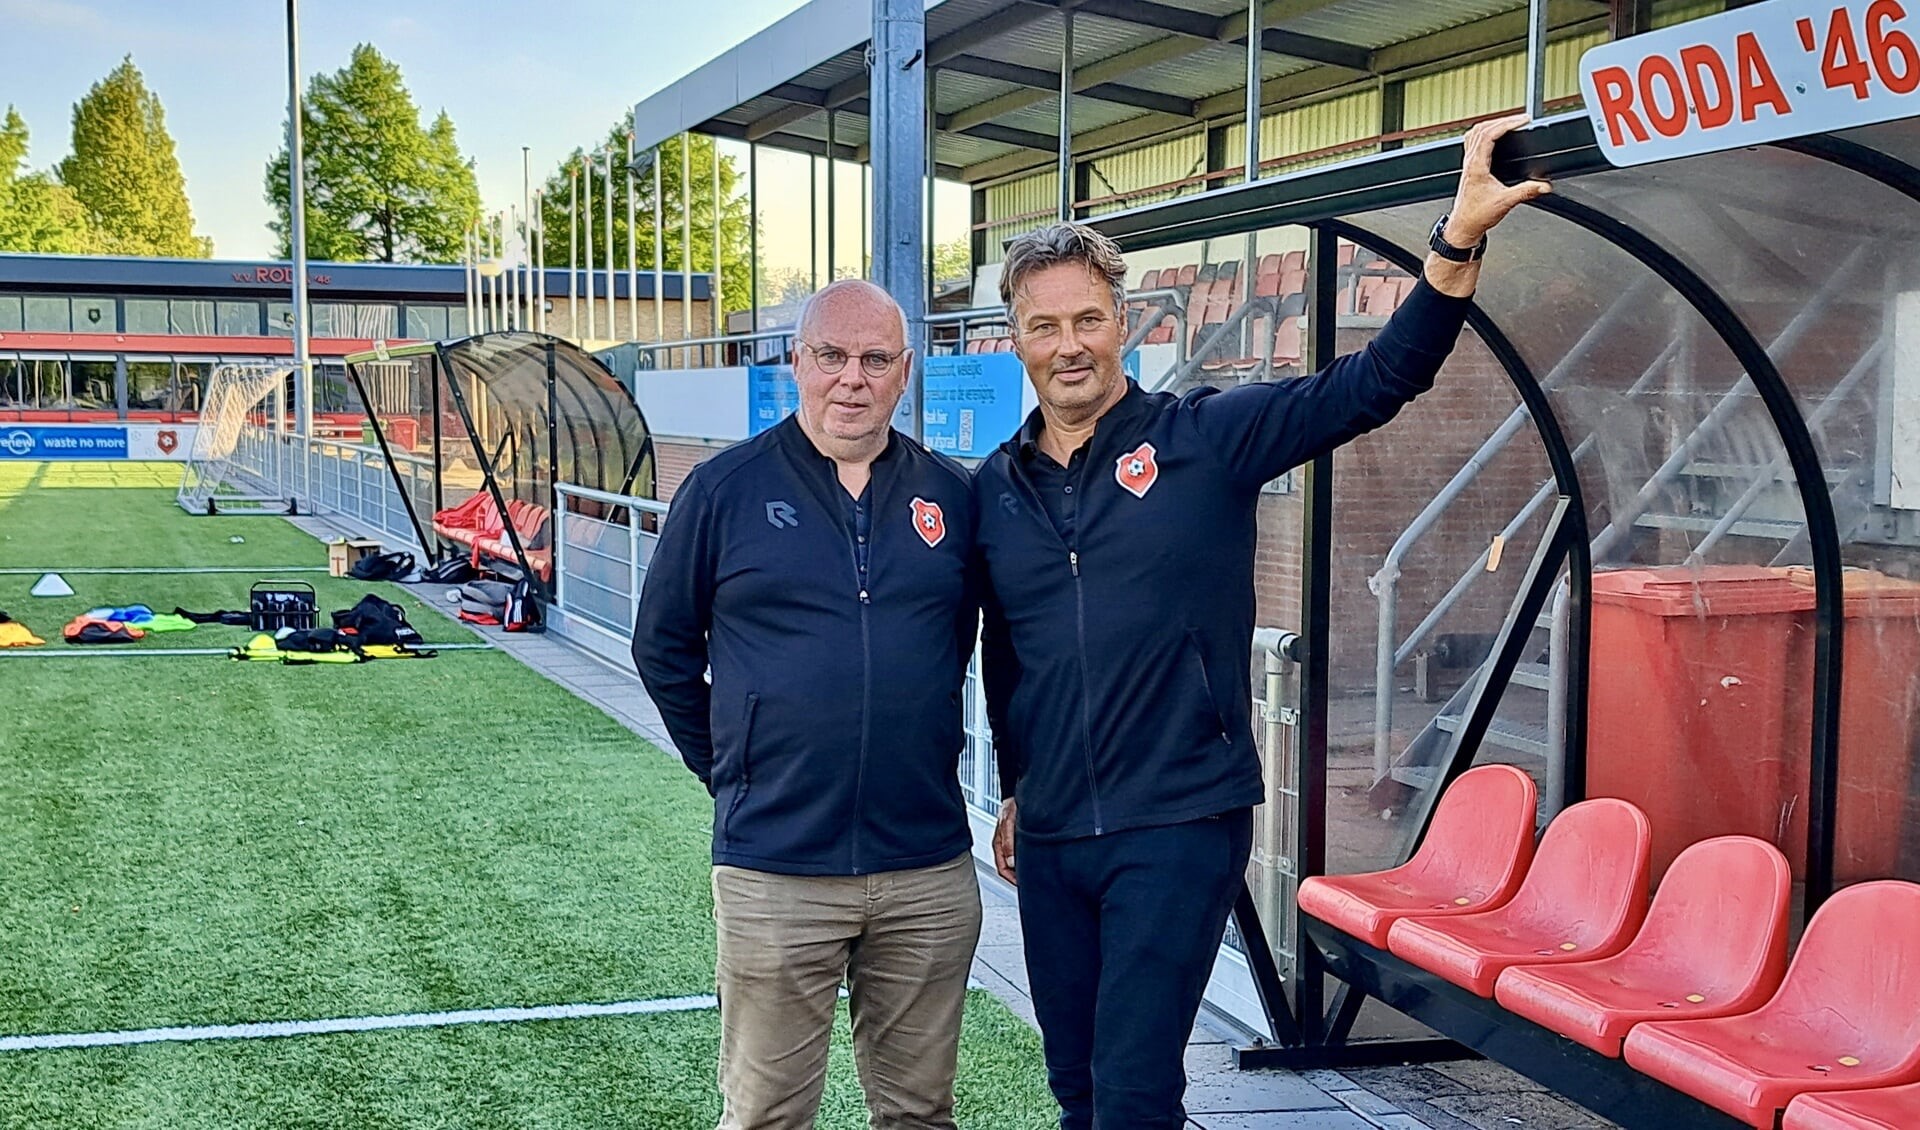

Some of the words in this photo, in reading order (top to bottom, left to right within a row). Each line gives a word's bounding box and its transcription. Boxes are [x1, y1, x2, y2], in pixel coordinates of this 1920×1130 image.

[1591, 31, 1793, 147] RODA
[1795, 0, 1920, 101] '46
[43, 437, 77, 448] waste
[80, 438, 94, 448] no
[96, 438, 126, 448] more
